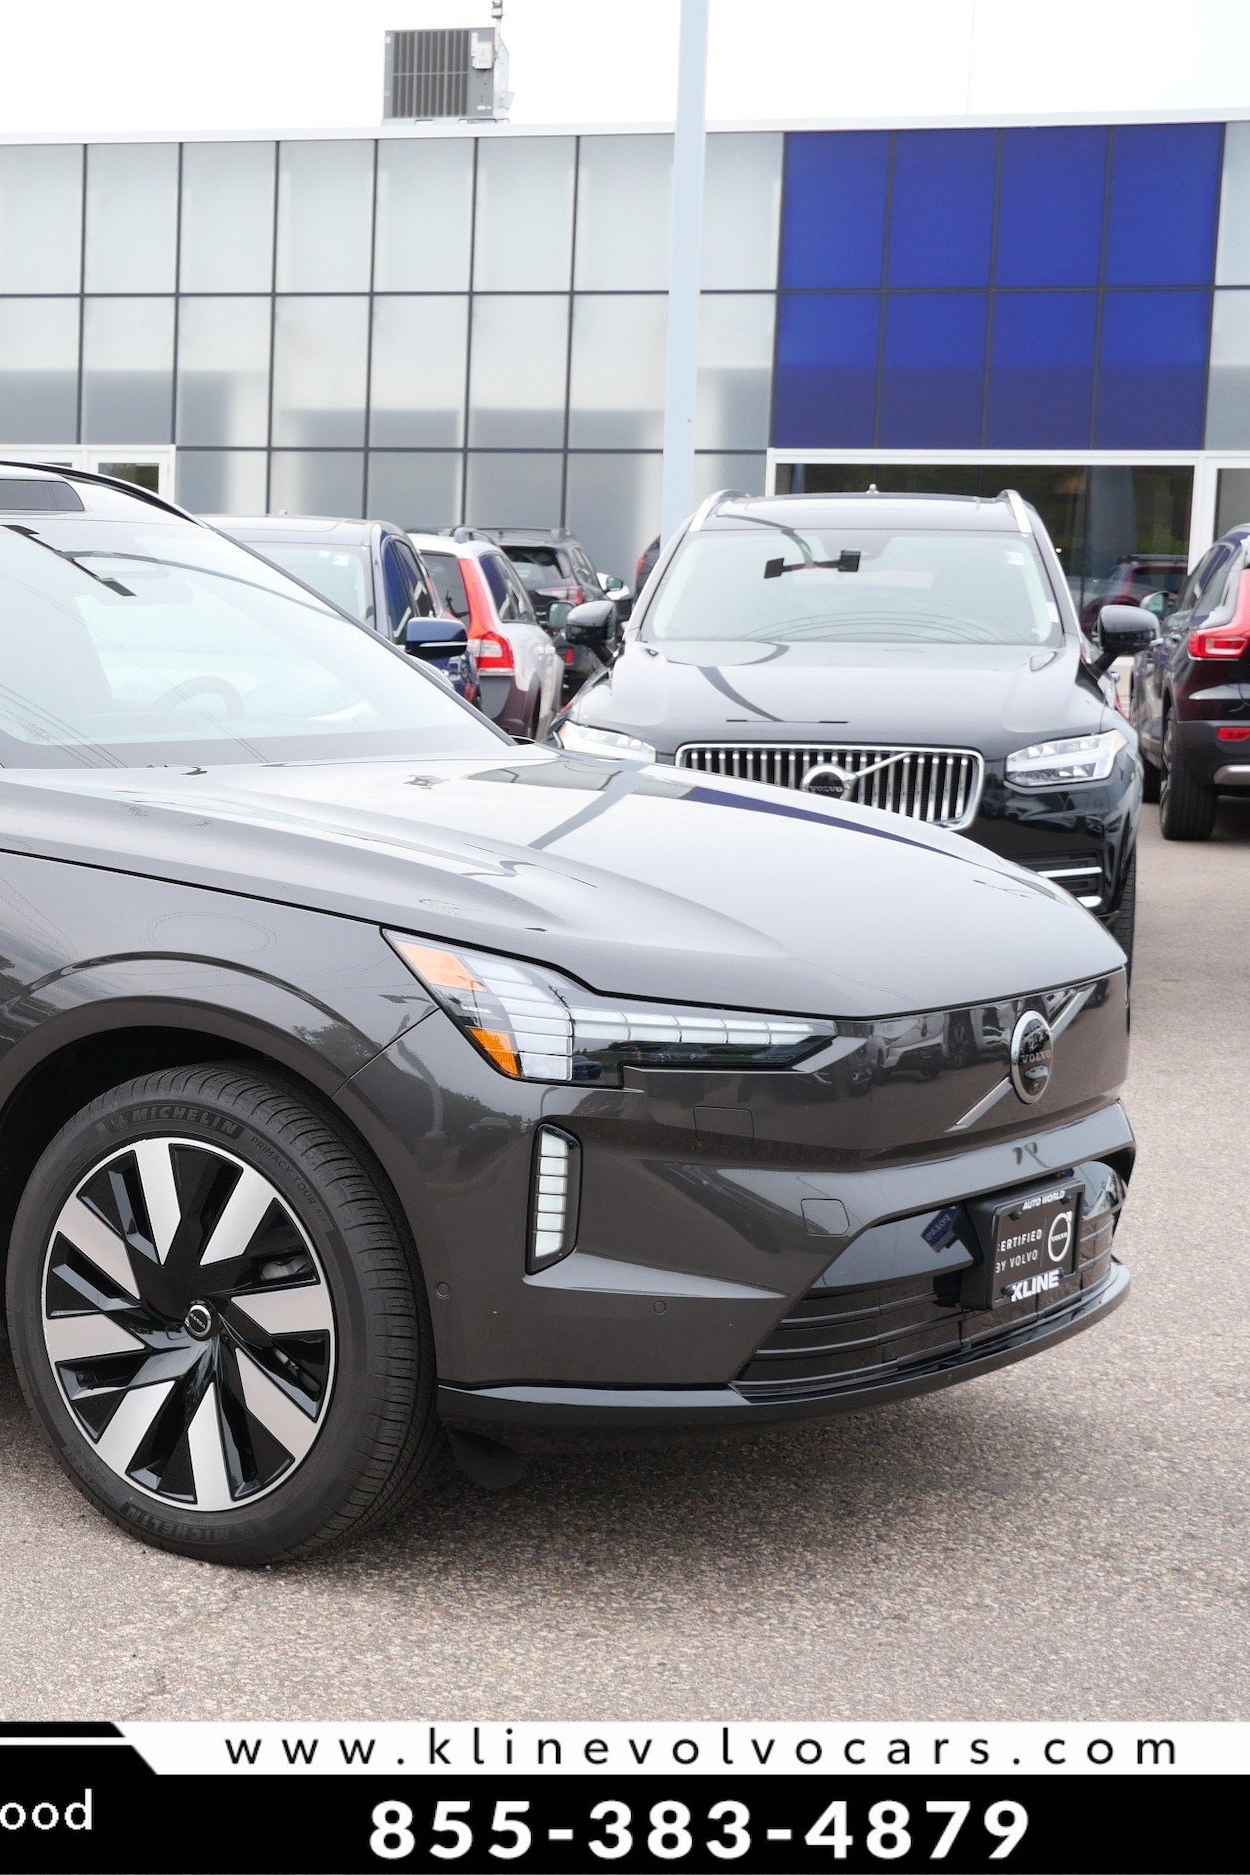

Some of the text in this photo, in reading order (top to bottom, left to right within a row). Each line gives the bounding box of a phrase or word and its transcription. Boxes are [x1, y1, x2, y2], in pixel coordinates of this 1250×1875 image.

[132, 1106, 239, 1136] MICHELIN
[250, 1136, 294, 1175] PRIMACY
[293, 1175, 317, 1206] TOUR
[1009, 1249, 1039, 1269] VOLVO
[126, 1505, 231, 1542] MICHELIN
